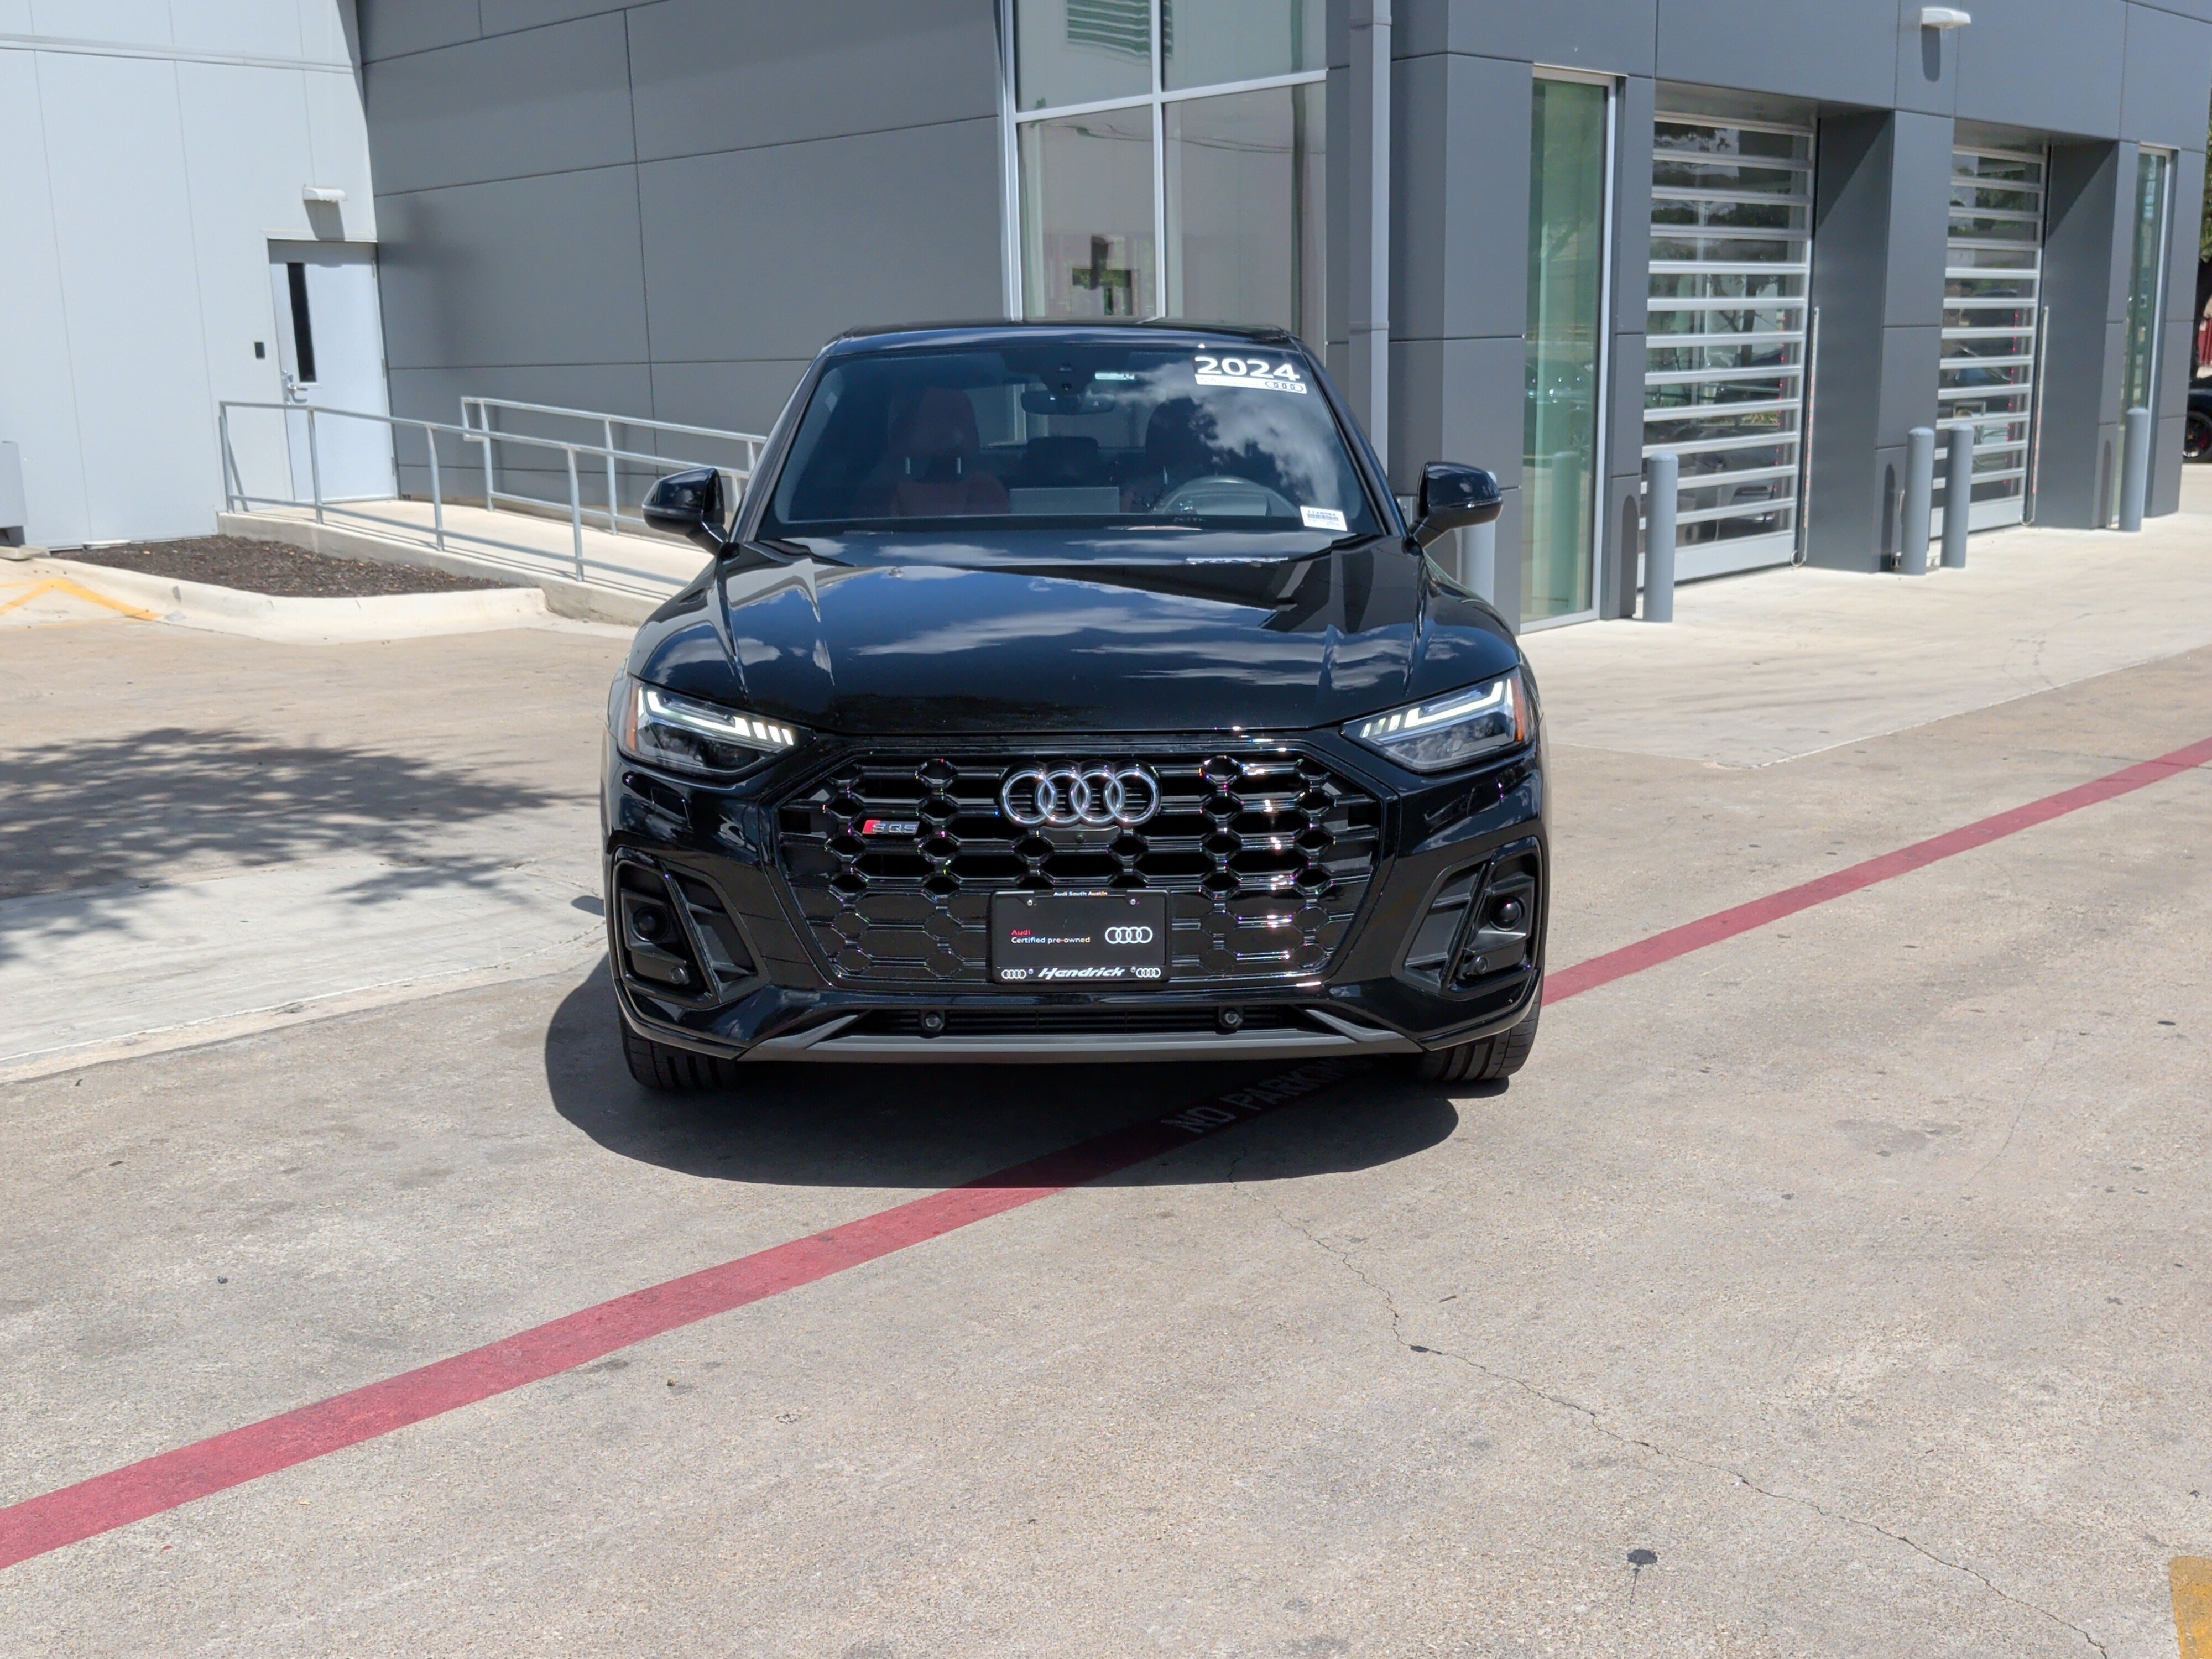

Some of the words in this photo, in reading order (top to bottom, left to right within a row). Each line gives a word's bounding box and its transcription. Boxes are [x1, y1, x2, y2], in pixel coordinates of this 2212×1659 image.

[1194, 356, 1300, 381] 2024
[872, 822, 917, 834] SQ5
[1038, 967, 1125, 980] Hendrick
[1160, 1105, 1237, 1134] NO
